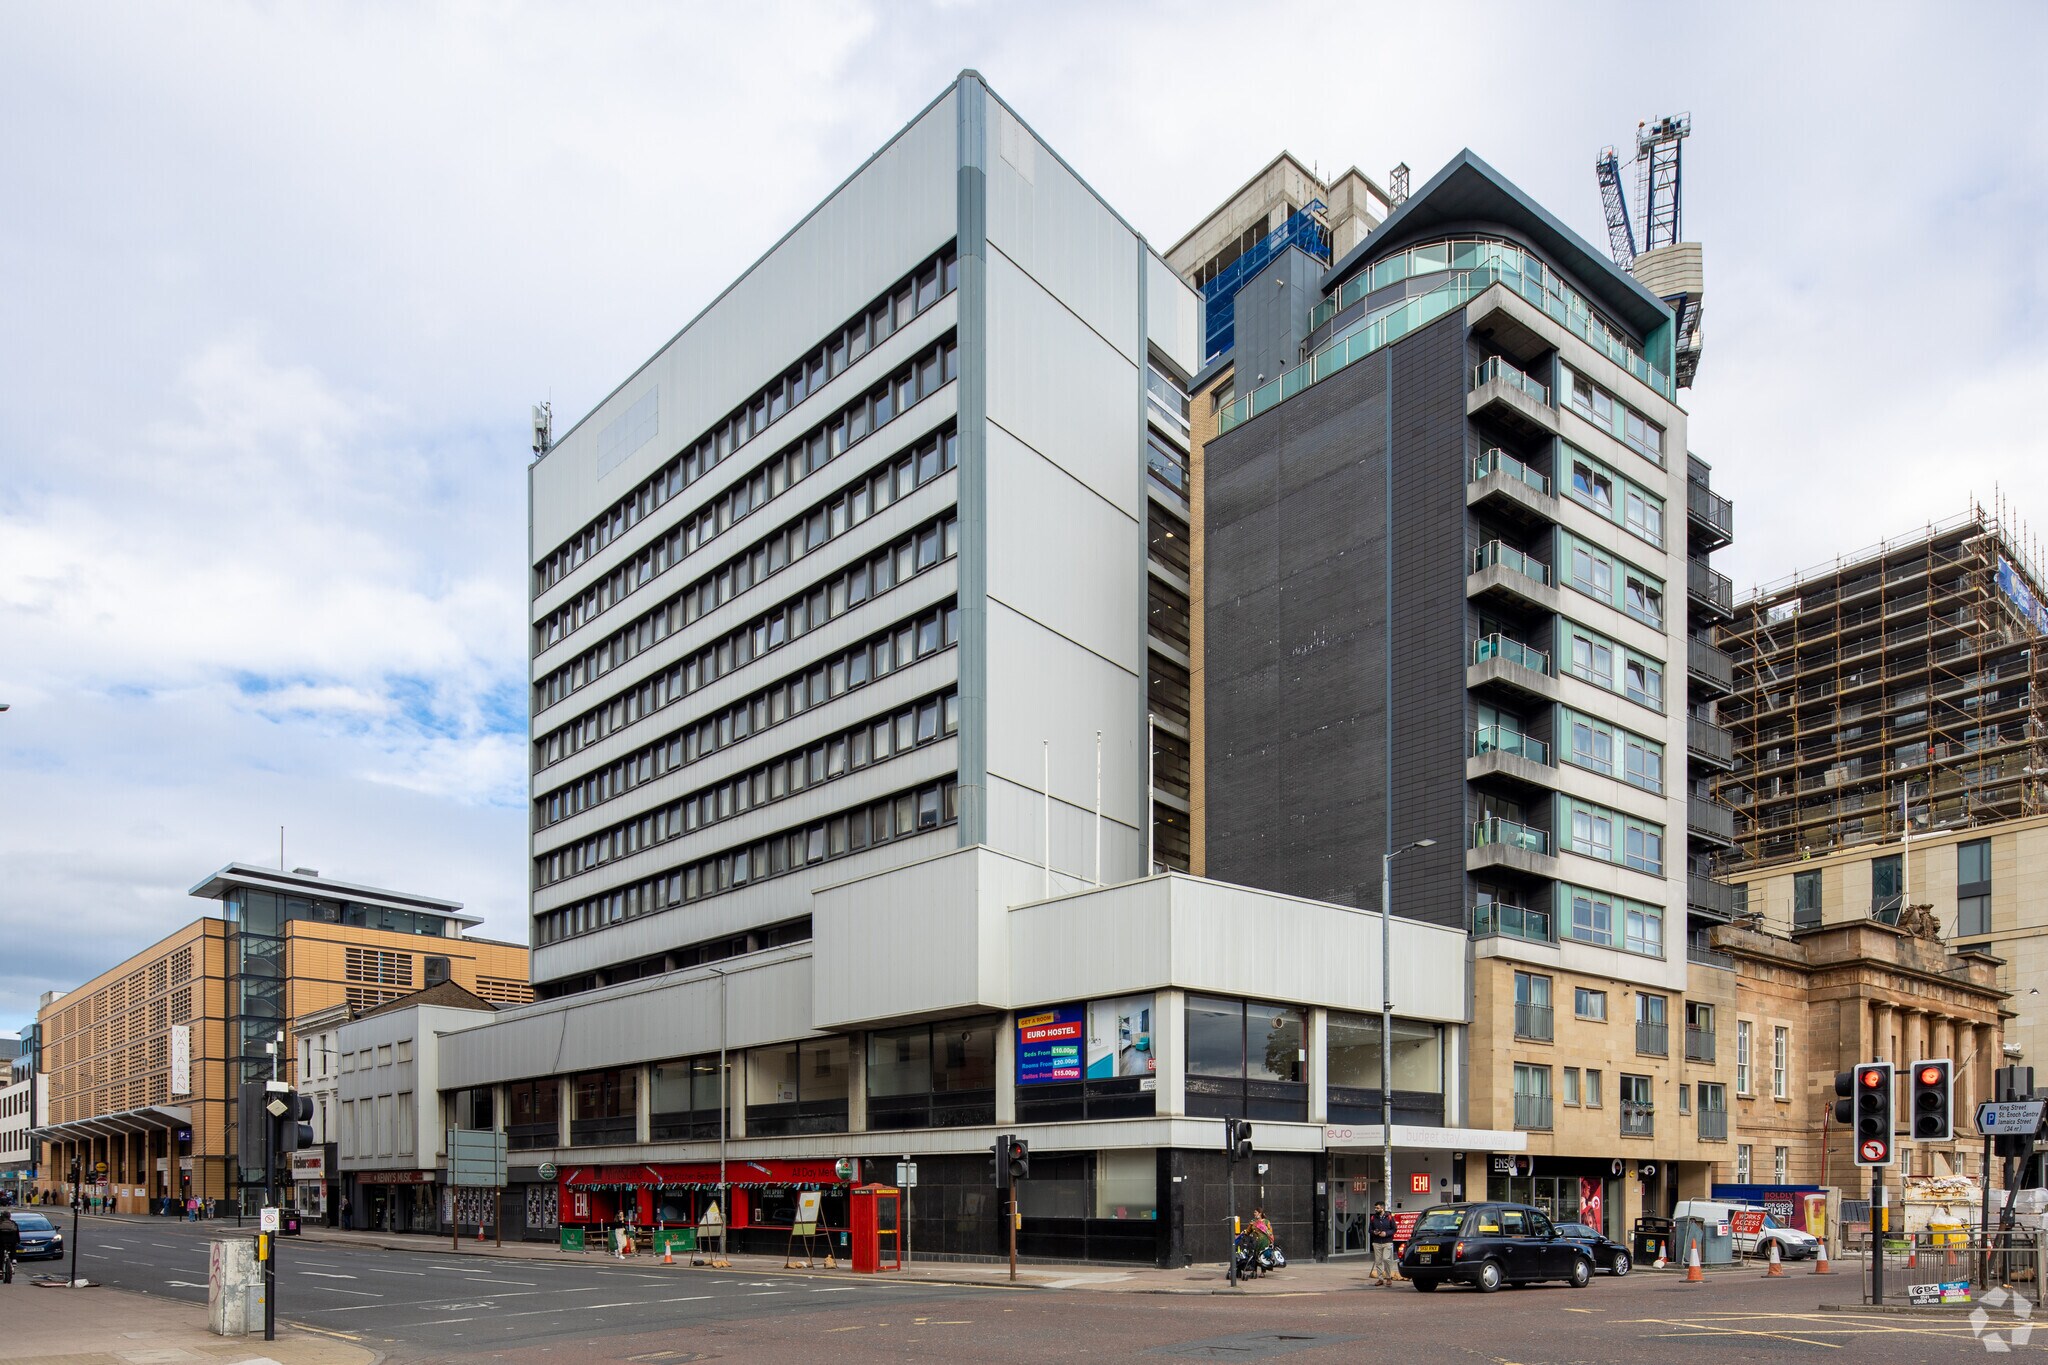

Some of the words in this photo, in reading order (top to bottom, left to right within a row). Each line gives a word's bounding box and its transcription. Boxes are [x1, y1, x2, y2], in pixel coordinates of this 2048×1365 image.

[1036, 1015, 1052, 1023] ROOM
[1027, 1030, 1046, 1039] EURO
[1047, 1027, 1075, 1037] HOSTEL
[1052, 1047, 1077, 1055] £10.00pp
[176, 1030, 187, 1090] MATALAN
[1053, 1058, 1078, 1066] £20.00pp
[1054, 1069, 1079, 1077] £15.00pp
[1988, 1113, 1995, 1124] P
[1326, 1129, 1352, 1139] euro
[1406, 1128, 1439, 1144] budget
[1441, 1132, 1460, 1146] stay
[1468, 1135, 1488, 1147] your
[1490, 1135, 1508, 1147] way
[377, 1172, 397, 1183] KENNY'S
[397, 1172, 412, 1183] MUSIC
[792, 1167, 801, 1177] All
[802, 1167, 816, 1179] Day
[818, 1167, 838, 1177] Men
[1413, 1175, 1428, 1191] EH!
